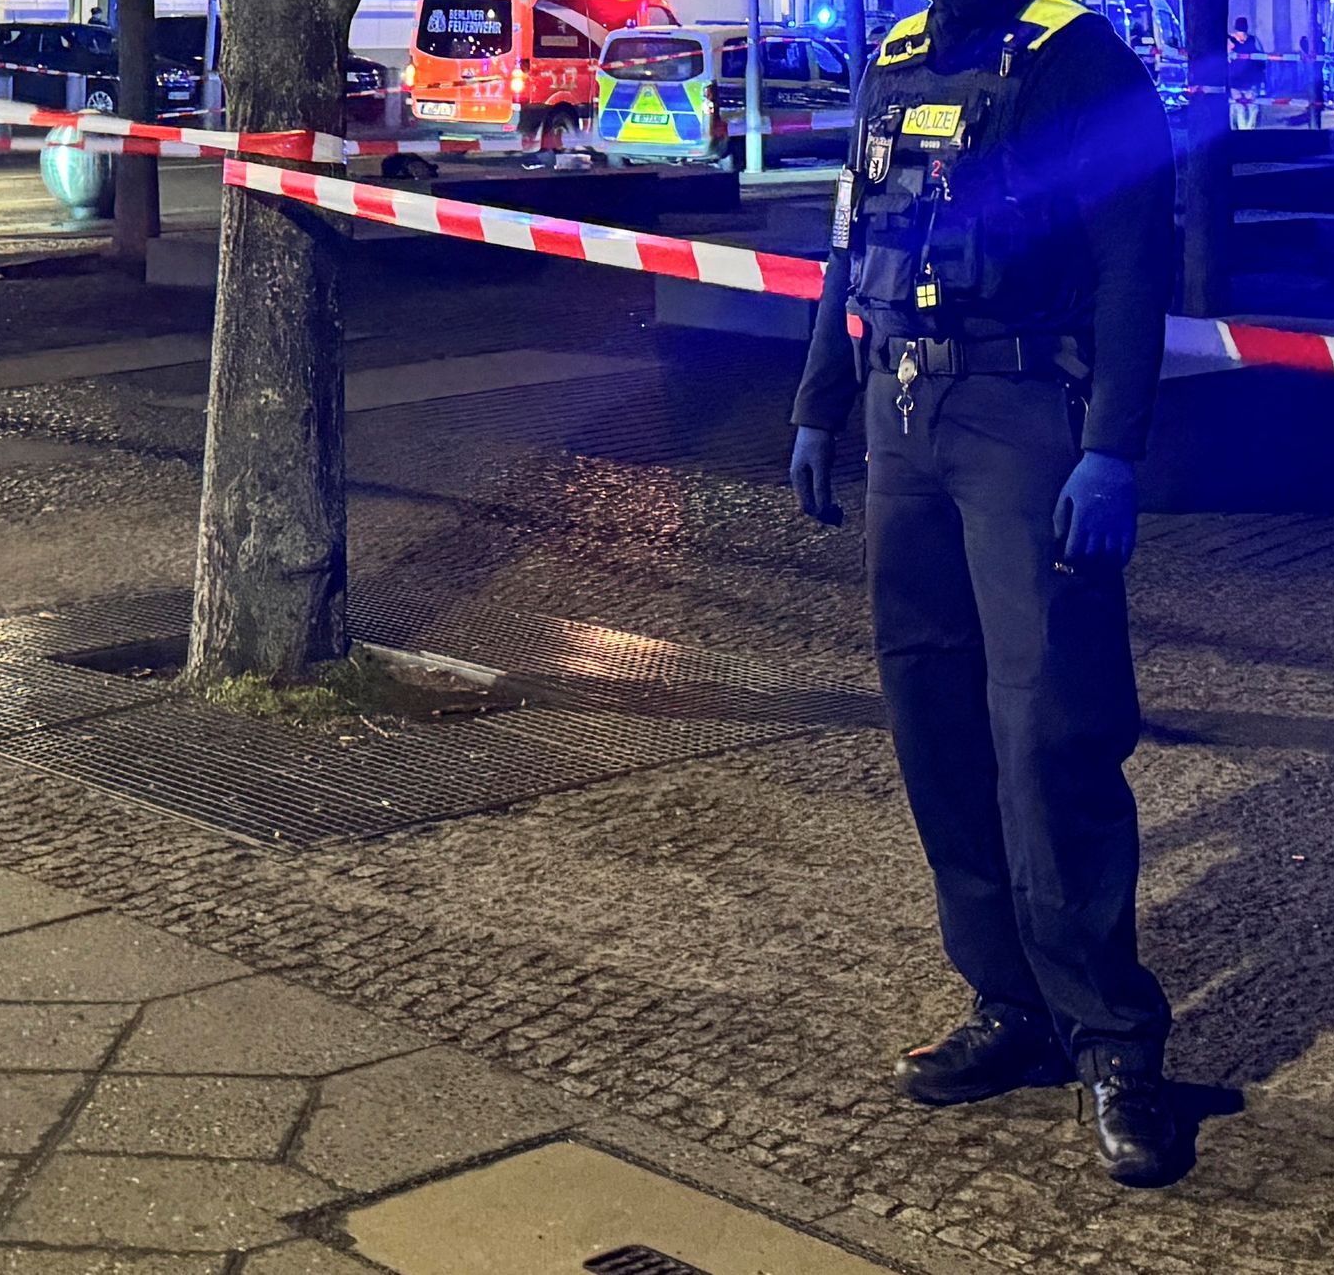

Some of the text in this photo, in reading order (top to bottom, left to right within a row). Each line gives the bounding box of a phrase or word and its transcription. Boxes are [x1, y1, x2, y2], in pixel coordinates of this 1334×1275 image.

[449, 9, 485, 20] BERLINER
[448, 21, 502, 34] FEUERWEHR
[472, 80, 505, 98] 112
[907, 110, 957, 131] POLIZEI
[931, 160, 942, 178] 2
